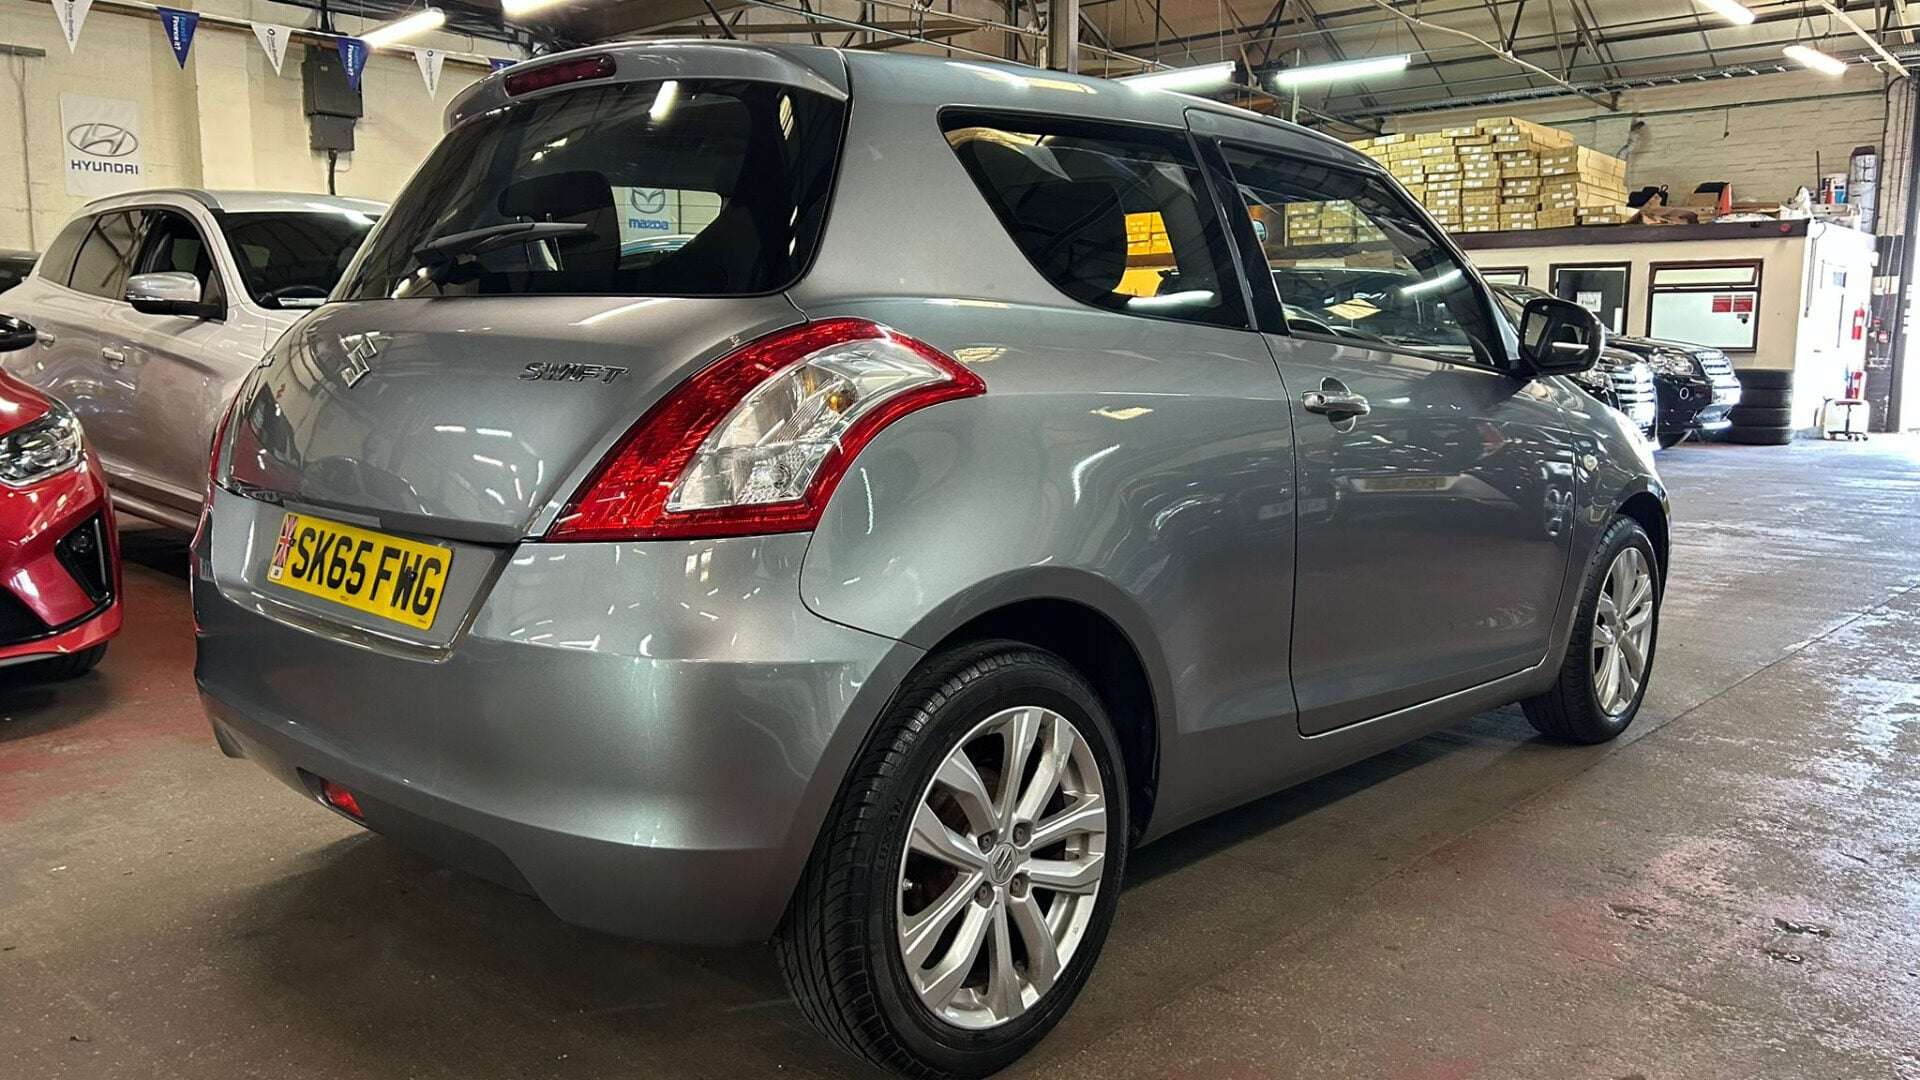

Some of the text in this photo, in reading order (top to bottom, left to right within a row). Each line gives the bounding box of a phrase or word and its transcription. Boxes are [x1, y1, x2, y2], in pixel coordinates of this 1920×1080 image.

[171, 15, 180, 40] Finance
[71, 160, 139, 175] HYUNDAI
[628, 218, 669, 230] mazda
[517, 362, 628, 384] SWIFT
[291, 527, 441, 616] SK65 FWG
